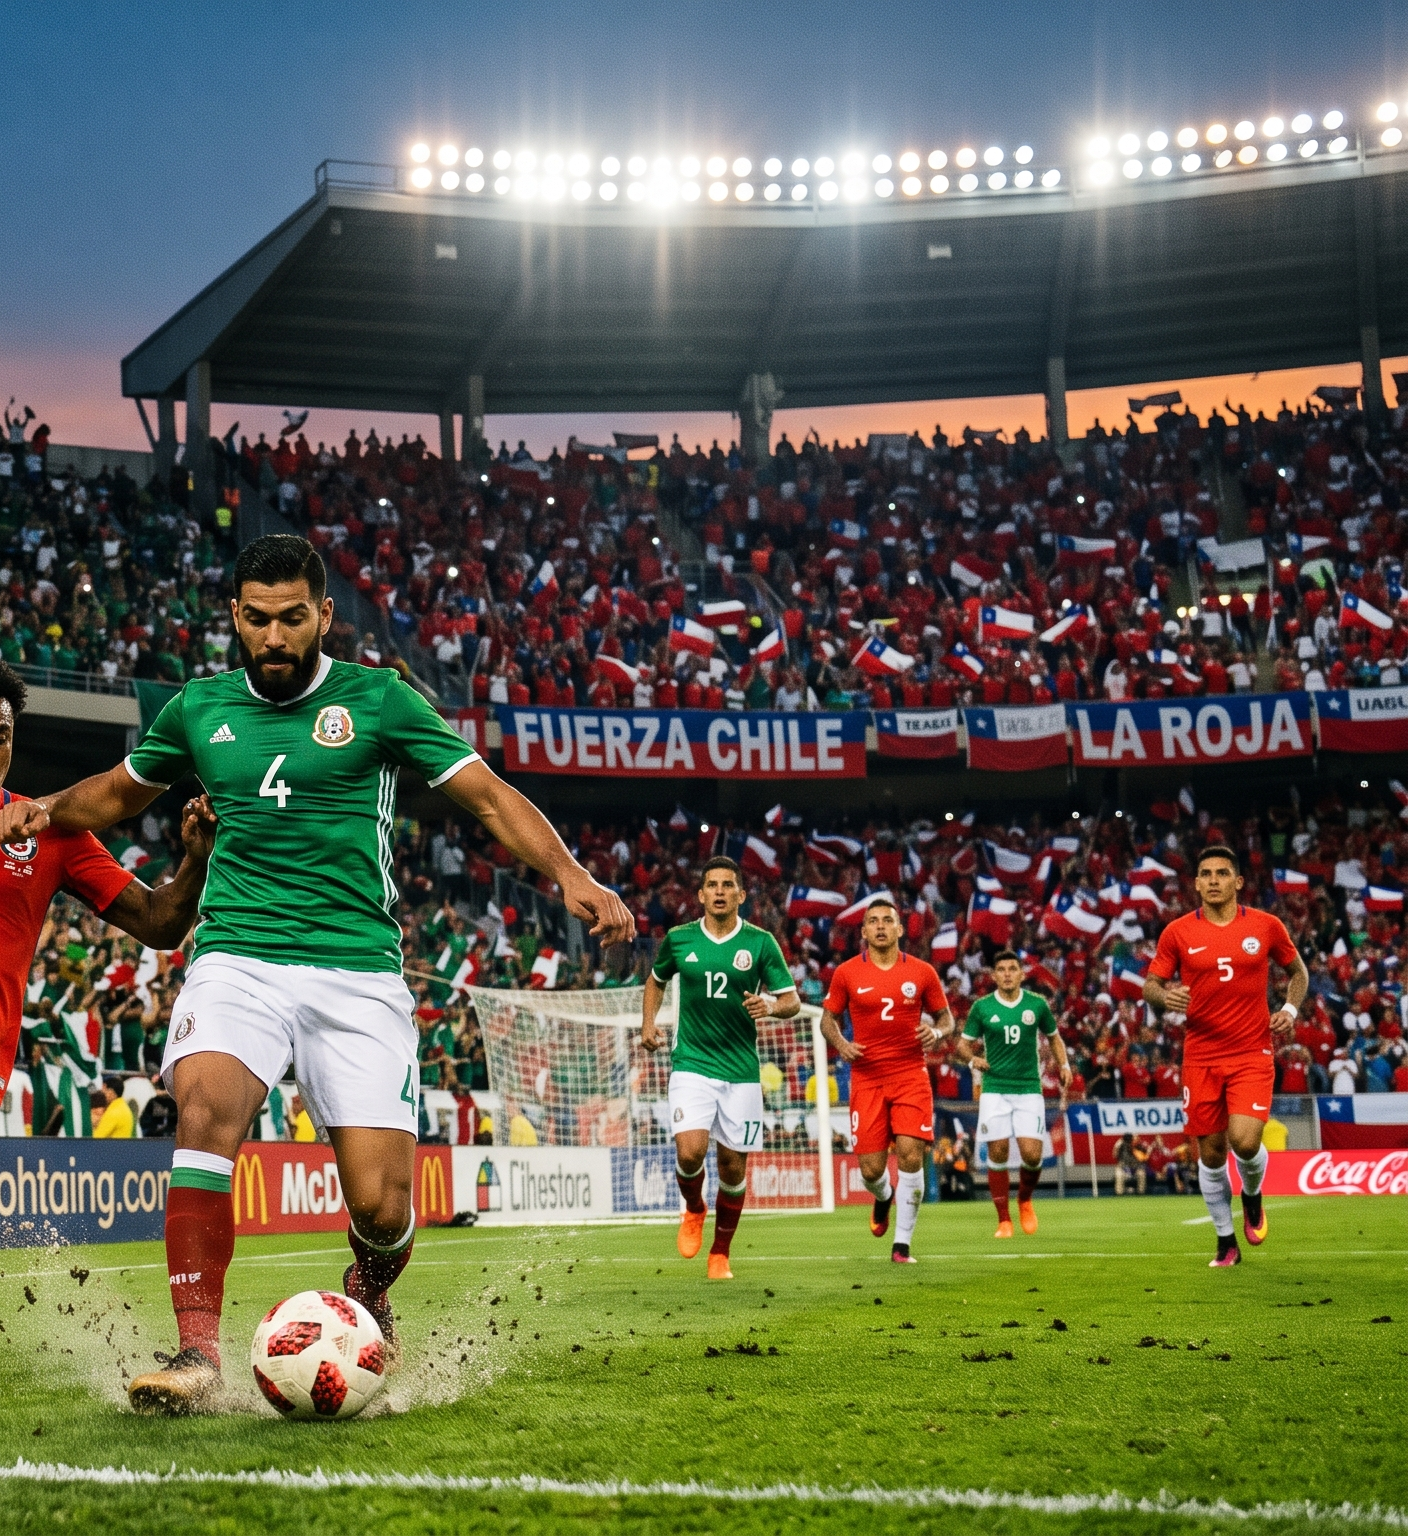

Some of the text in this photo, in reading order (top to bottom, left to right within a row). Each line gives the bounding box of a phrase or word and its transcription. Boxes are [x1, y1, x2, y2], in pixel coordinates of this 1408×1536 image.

[513, 712, 695, 769] FUERZA
[707, 717, 845, 771] CHILE
[1075, 709, 1146, 760] LA
[1159, 699, 1305, 758] ROJA
[259, 754, 291, 808] 4
[1217, 957, 1234, 982] 5
[704, 971, 728, 999] 12
[880, 997, 894, 1021] 2
[1003, 1025, 1020, 1045] 19
[400, 1064, 416, 1117] 4
[1102, 1107, 1184, 1127] LA ROJA
[743, 1121, 760, 1145] 17
